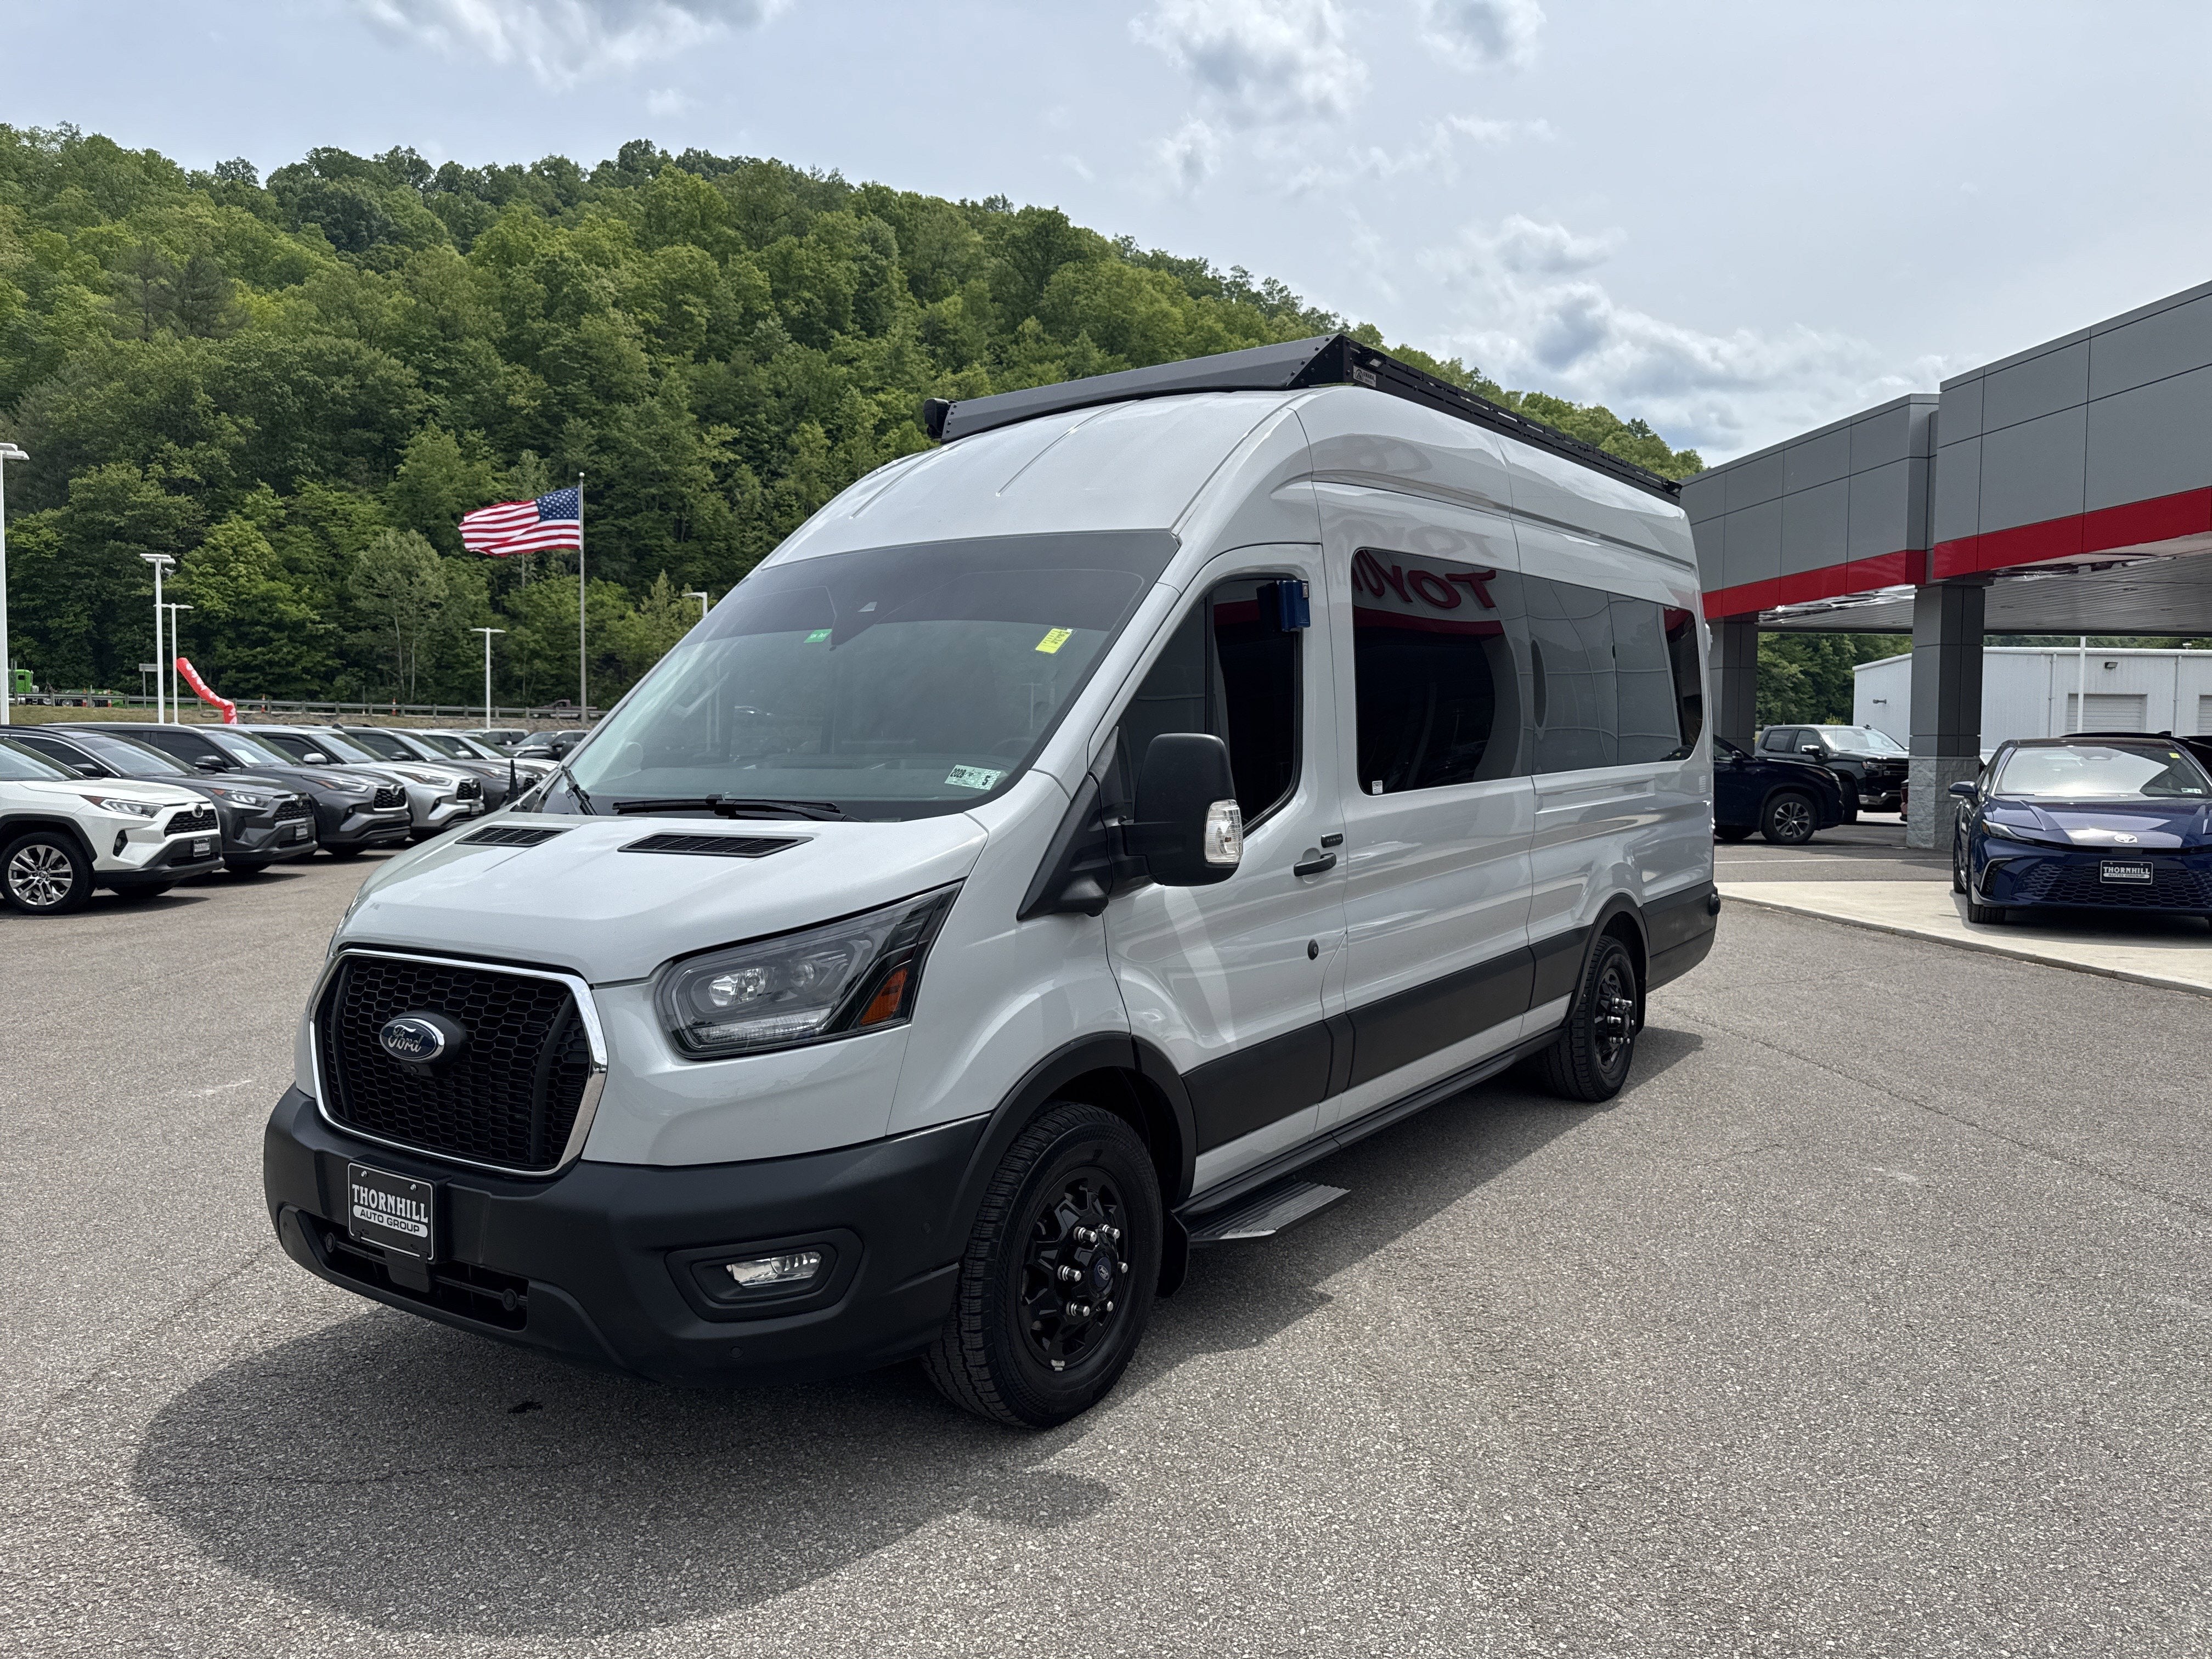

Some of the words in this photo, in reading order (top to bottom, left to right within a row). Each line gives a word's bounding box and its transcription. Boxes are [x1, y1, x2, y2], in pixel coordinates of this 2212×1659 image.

[950, 768, 966, 778] 2028
[982, 775, 990, 786] 5
[388, 1024, 424, 1052] Ford
[352, 1184, 428, 1223] THORNHILL
[360, 1209, 383, 1223] AUTO
[387, 1217, 419, 1233] GROUP
